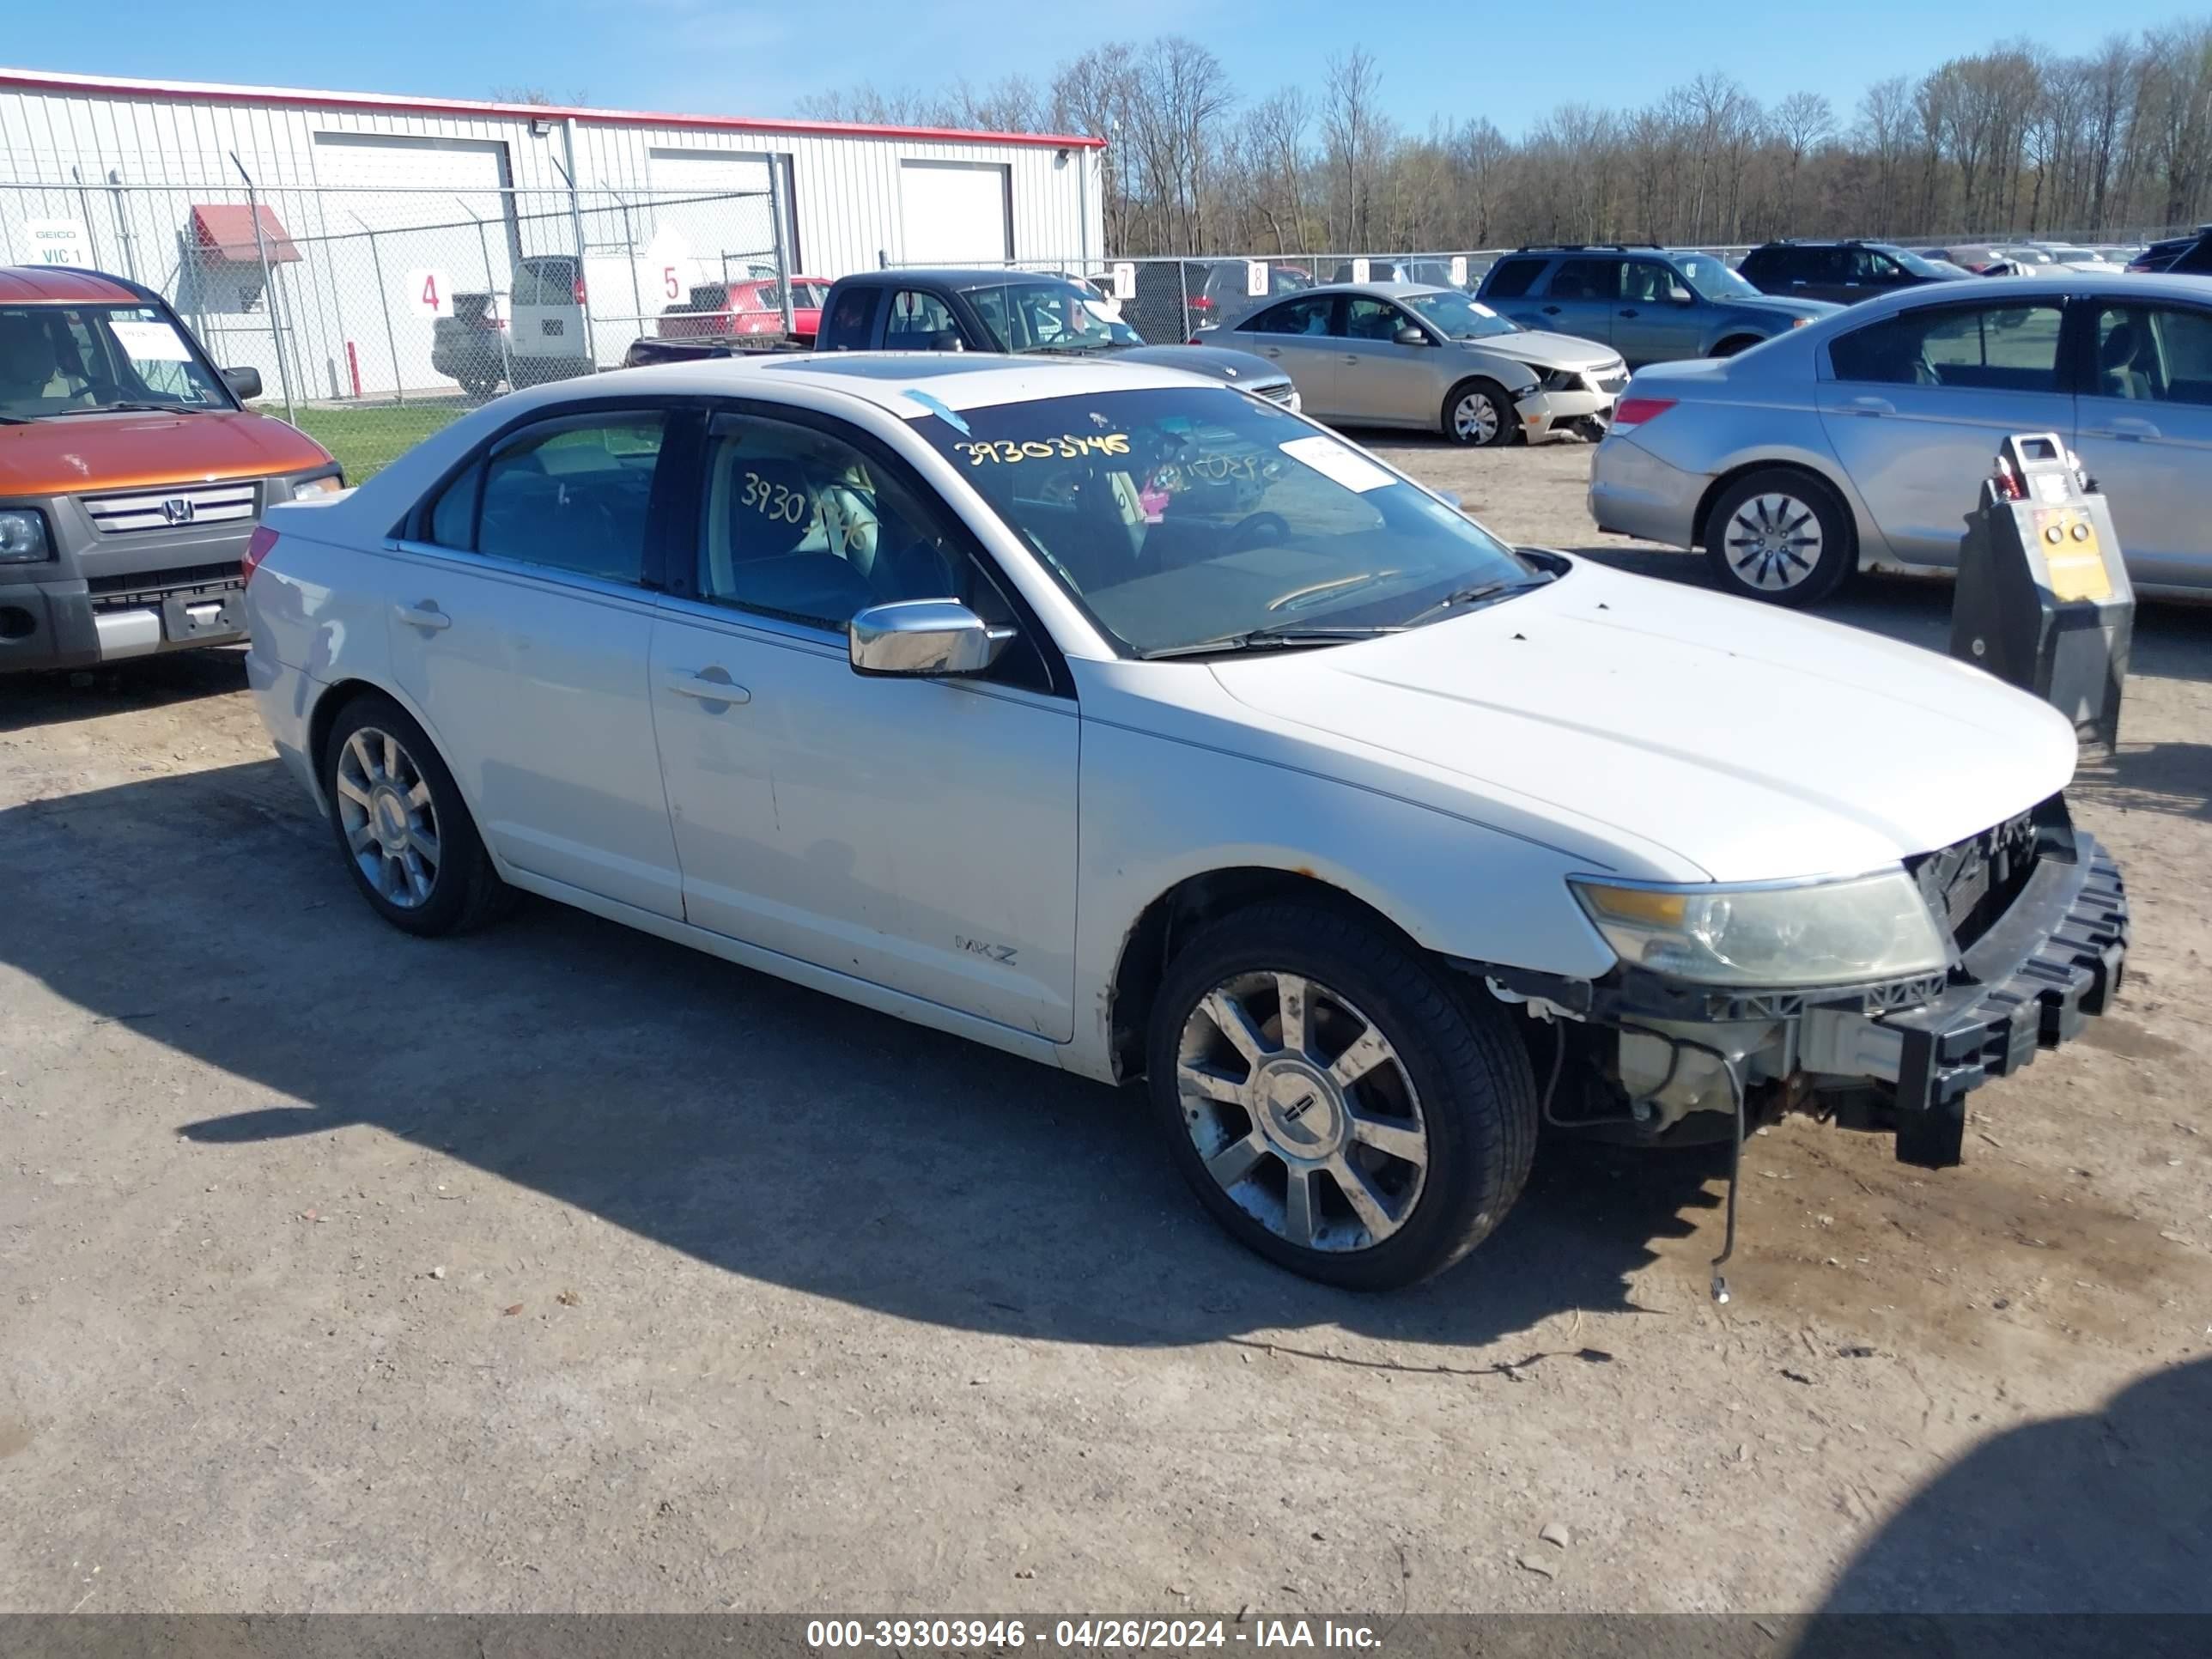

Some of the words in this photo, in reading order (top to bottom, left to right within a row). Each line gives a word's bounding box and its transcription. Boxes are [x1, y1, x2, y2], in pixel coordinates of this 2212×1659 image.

[42, 249, 69, 264] VIC
[74, 249, 82, 264] 1
[664, 266, 678, 299] 5
[1121, 269, 1128, 295] 7
[1255, 268, 1262, 291] 8
[1455, 261, 1465, 282] 10
[422, 275, 440, 311] 4
[955, 934, 1018, 966] MKZ
